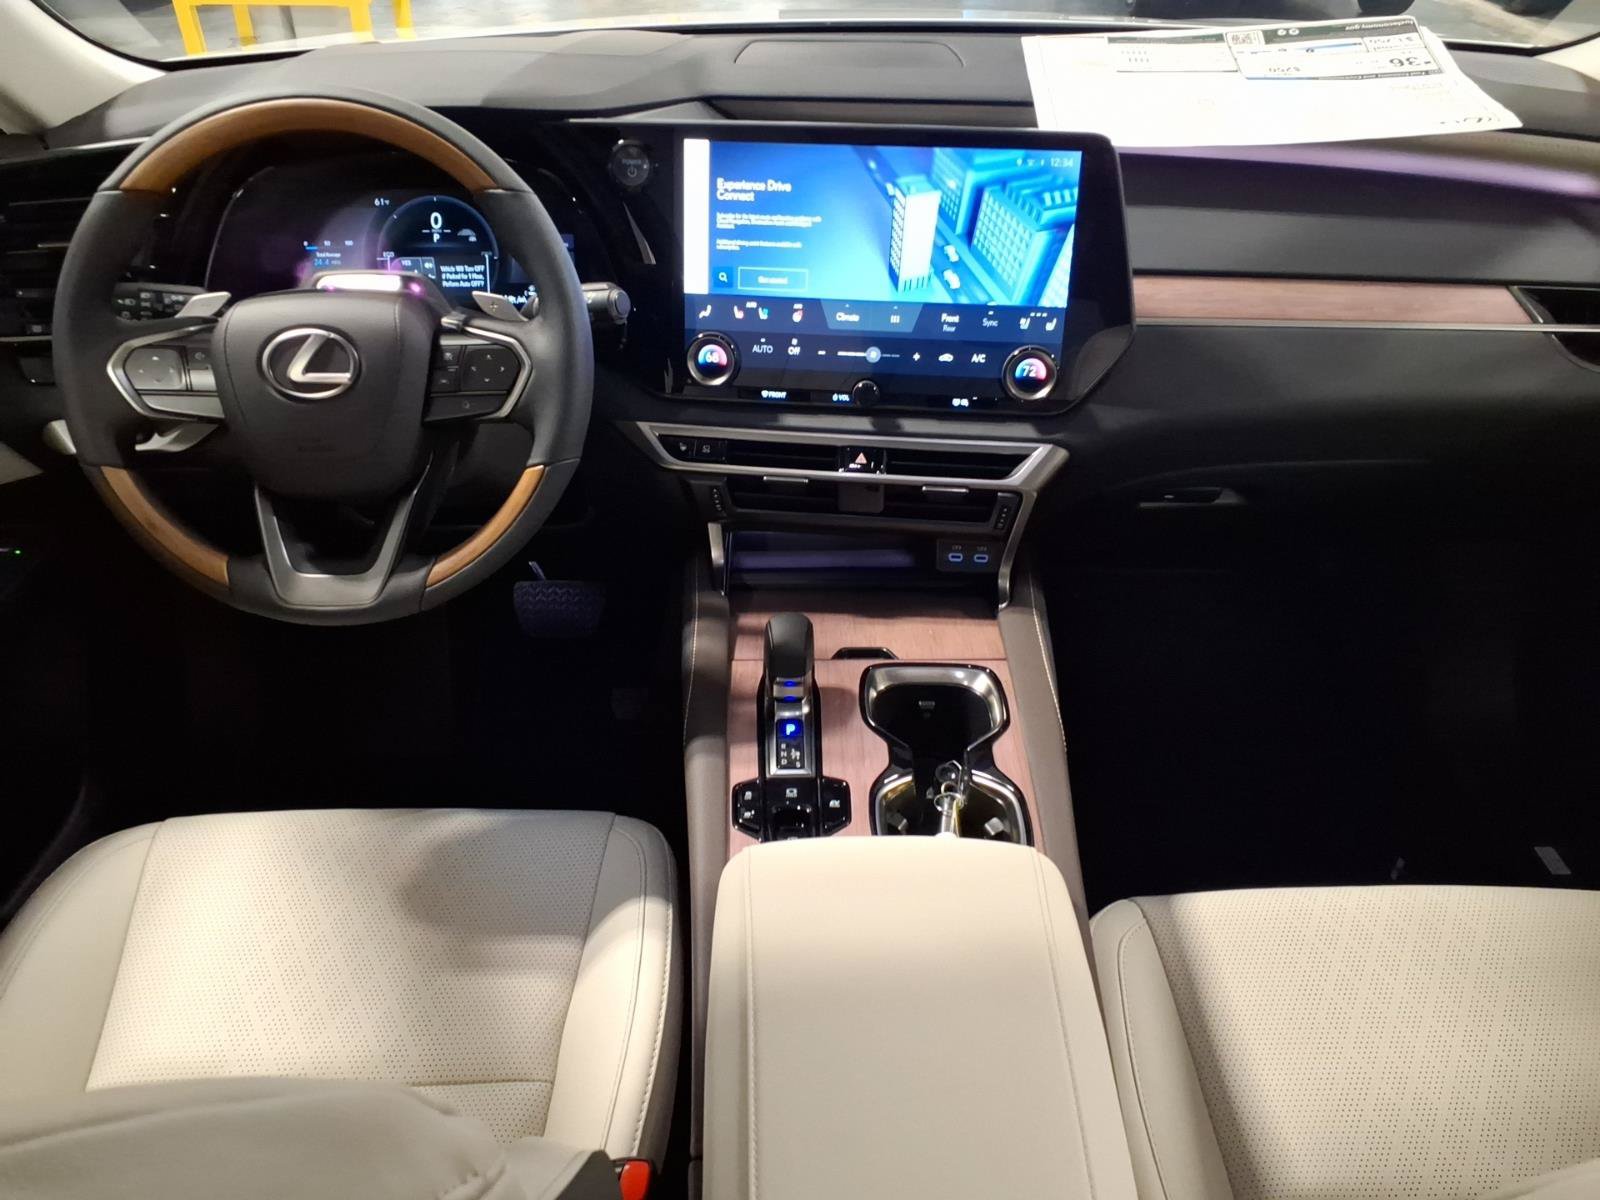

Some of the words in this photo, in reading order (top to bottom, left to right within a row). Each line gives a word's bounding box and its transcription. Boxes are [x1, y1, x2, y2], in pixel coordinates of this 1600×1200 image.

[716, 177, 766, 191] Experience
[767, 179, 792, 192] Drive
[716, 190, 755, 201] Connect
[430, 211, 443, 229] 0
[433, 233, 441, 243] P
[836, 311, 860, 322] Climate
[941, 312, 960, 323] Front
[982, 317, 998, 328] Sync
[752, 344, 773, 354] AUTO
[705, 351, 720, 363] 68
[971, 353, 986, 364] A/C
[1022, 364, 1037, 378] 72
[785, 723, 796, 736] P
